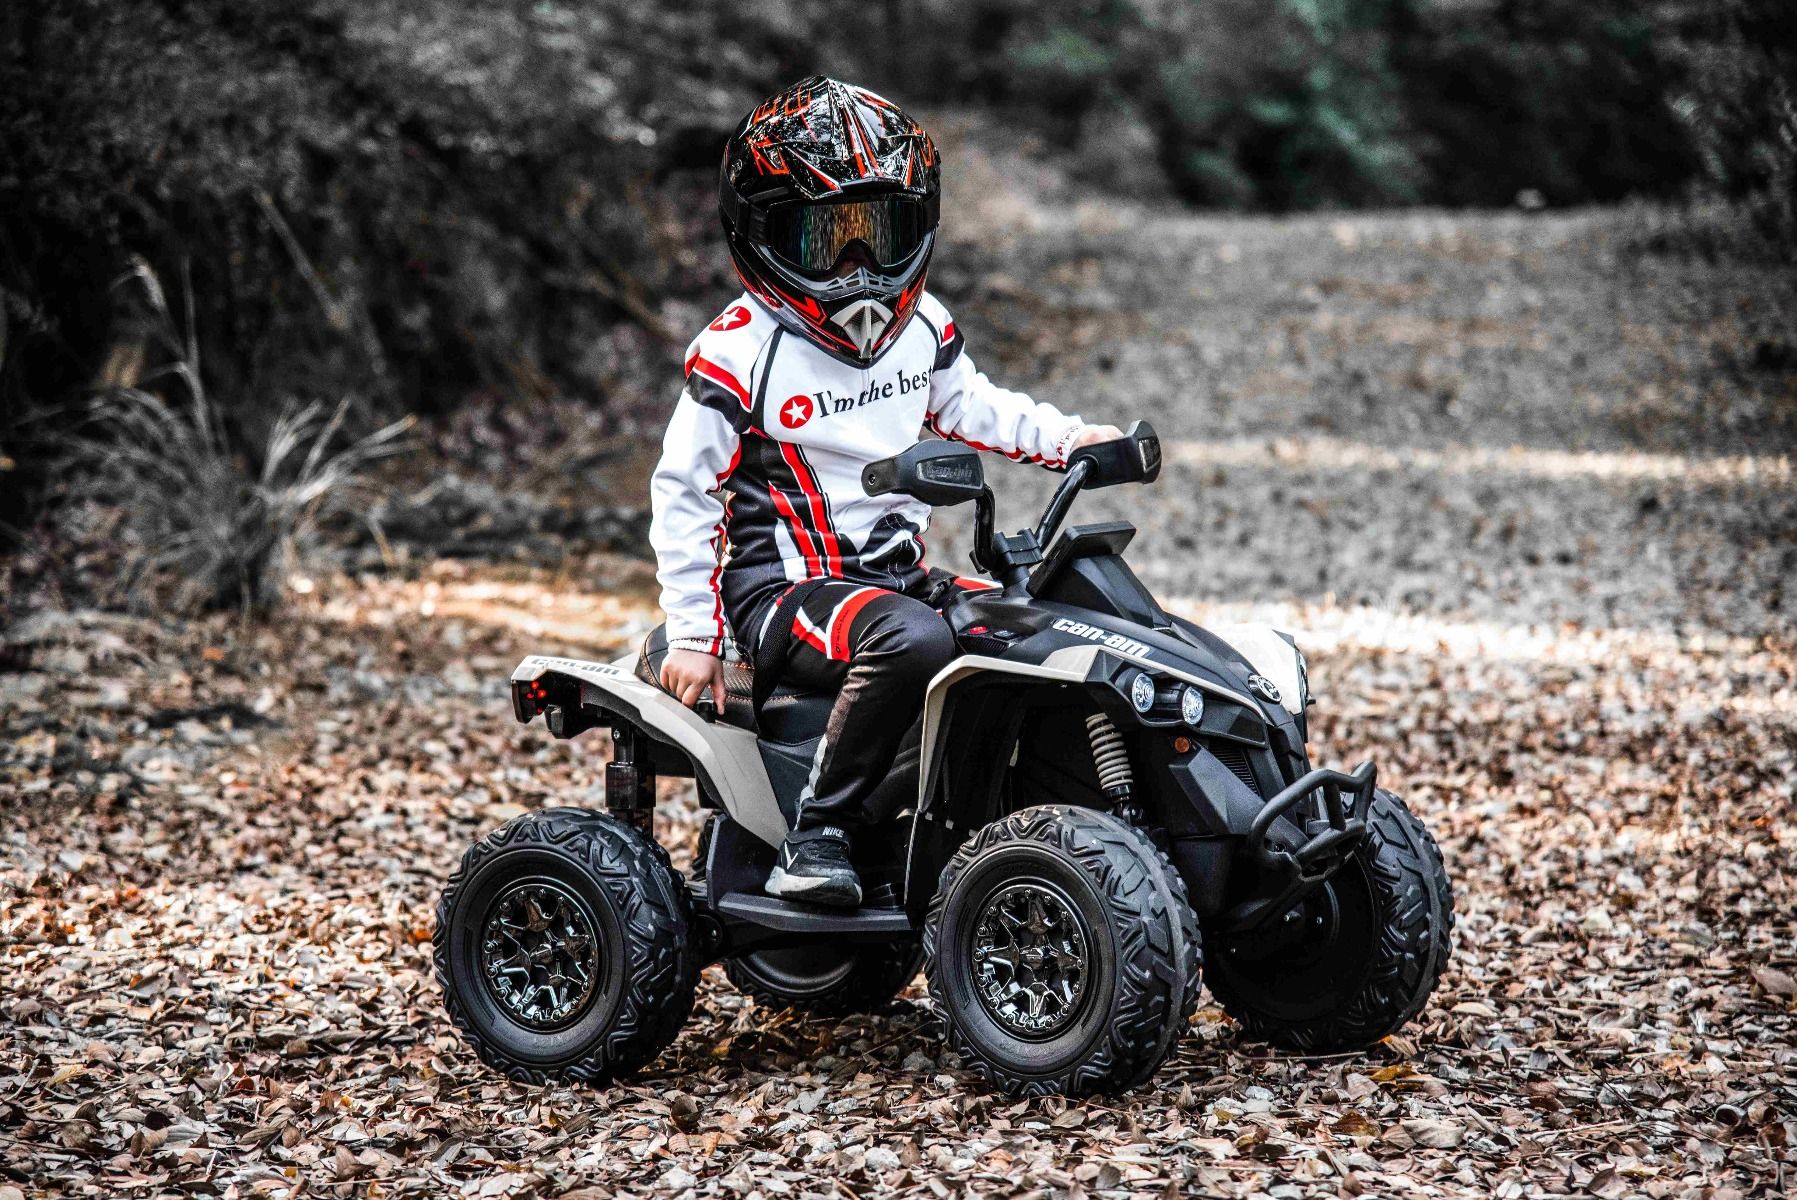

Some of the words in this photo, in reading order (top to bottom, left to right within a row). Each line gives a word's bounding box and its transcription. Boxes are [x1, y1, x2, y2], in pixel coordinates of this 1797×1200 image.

[813, 390, 855, 418] I'm
[858, 379, 893, 407] the
[896, 365, 933, 395] best
[1052, 618, 1150, 657] can-am
[822, 826, 845, 838] NIKE
